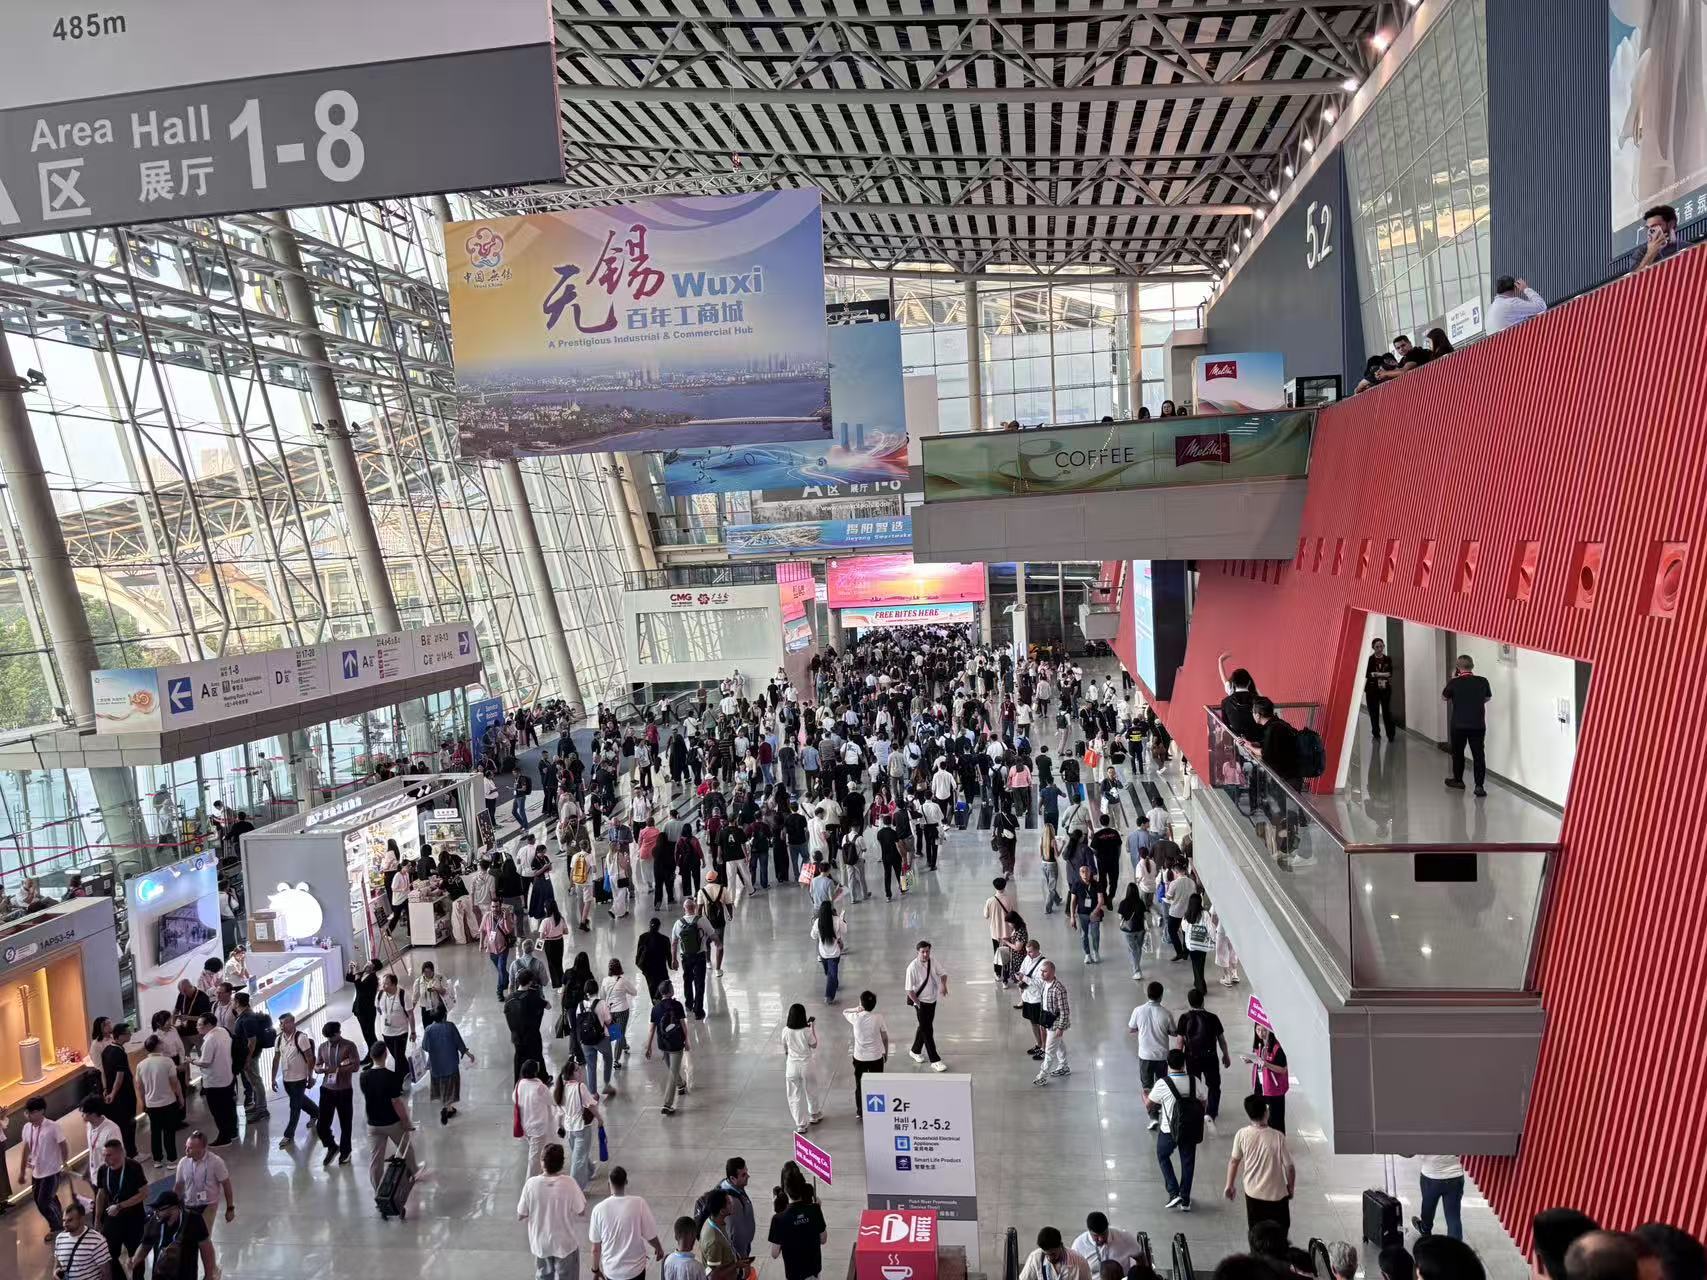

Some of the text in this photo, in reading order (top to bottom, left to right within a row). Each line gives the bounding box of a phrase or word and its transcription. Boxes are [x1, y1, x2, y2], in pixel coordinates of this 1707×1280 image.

[52, 11, 127, 42] 485m
[30, 89, 366, 190] Area Hall 1-8
[38, 157, 92, 222] 区
[139, 156, 215, 203] 展厅
[672, 266, 763, 299] Wuxi
[626, 300, 744, 330] 百年工商城
[548, 326, 754, 349] A Prestigious Industrial & Commercial Hub
[1208, 364, 1233, 376] Melitta
[1055, 438, 1224, 468] COFFEE Melitta
[670, 593, 692, 601] CMG
[875, 608, 940, 619] FREE BITES HERE
[421, 635, 427, 646] B
[363, 656, 369, 668] A
[423, 654, 429, 665] C
[229, 664, 239, 675] 1-8
[275, 671, 283, 684] D
[201, 683, 211, 698] A
[893, 1098, 910, 1112] 2F
[911, 1118, 951, 1130] 1.2-5.2
[796, 1141, 809, 1155] Hong
[916, 1217, 932, 1242] COFFEE
